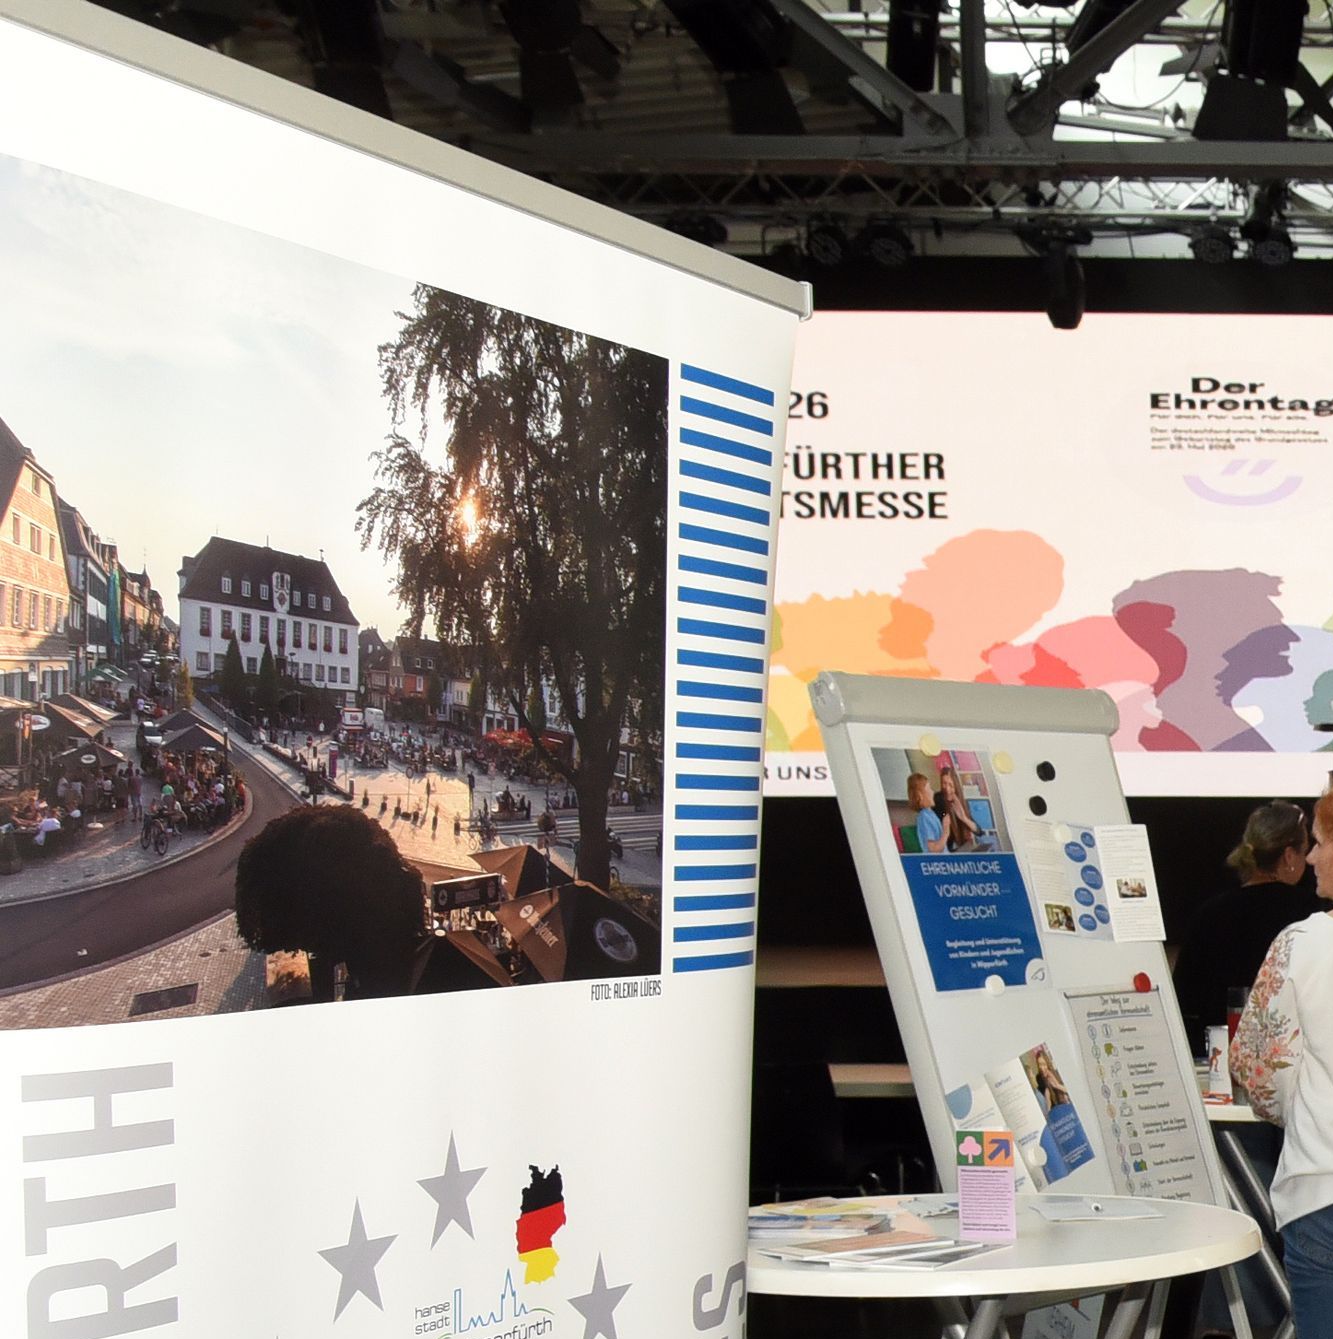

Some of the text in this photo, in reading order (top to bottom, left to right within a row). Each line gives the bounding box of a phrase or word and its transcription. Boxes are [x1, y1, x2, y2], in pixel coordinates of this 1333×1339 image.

[1191, 377, 1265, 394] Der
[788, 391, 829, 419] 26
[780, 491, 948, 519] TSMESSE
[778, 766, 828, 780] UNS
[921, 861, 1002, 876] EHRENAMTLICHE
[935, 882, 1000, 897] VORMÜNDER
[950, 905, 997, 920] GESUCHT
[591, 984, 612, 1001] FOTO:
[613, 982, 638, 999] ALEXIA
[415, 1301, 451, 1320] hanse
[415, 1316, 450, 1335] stadt
